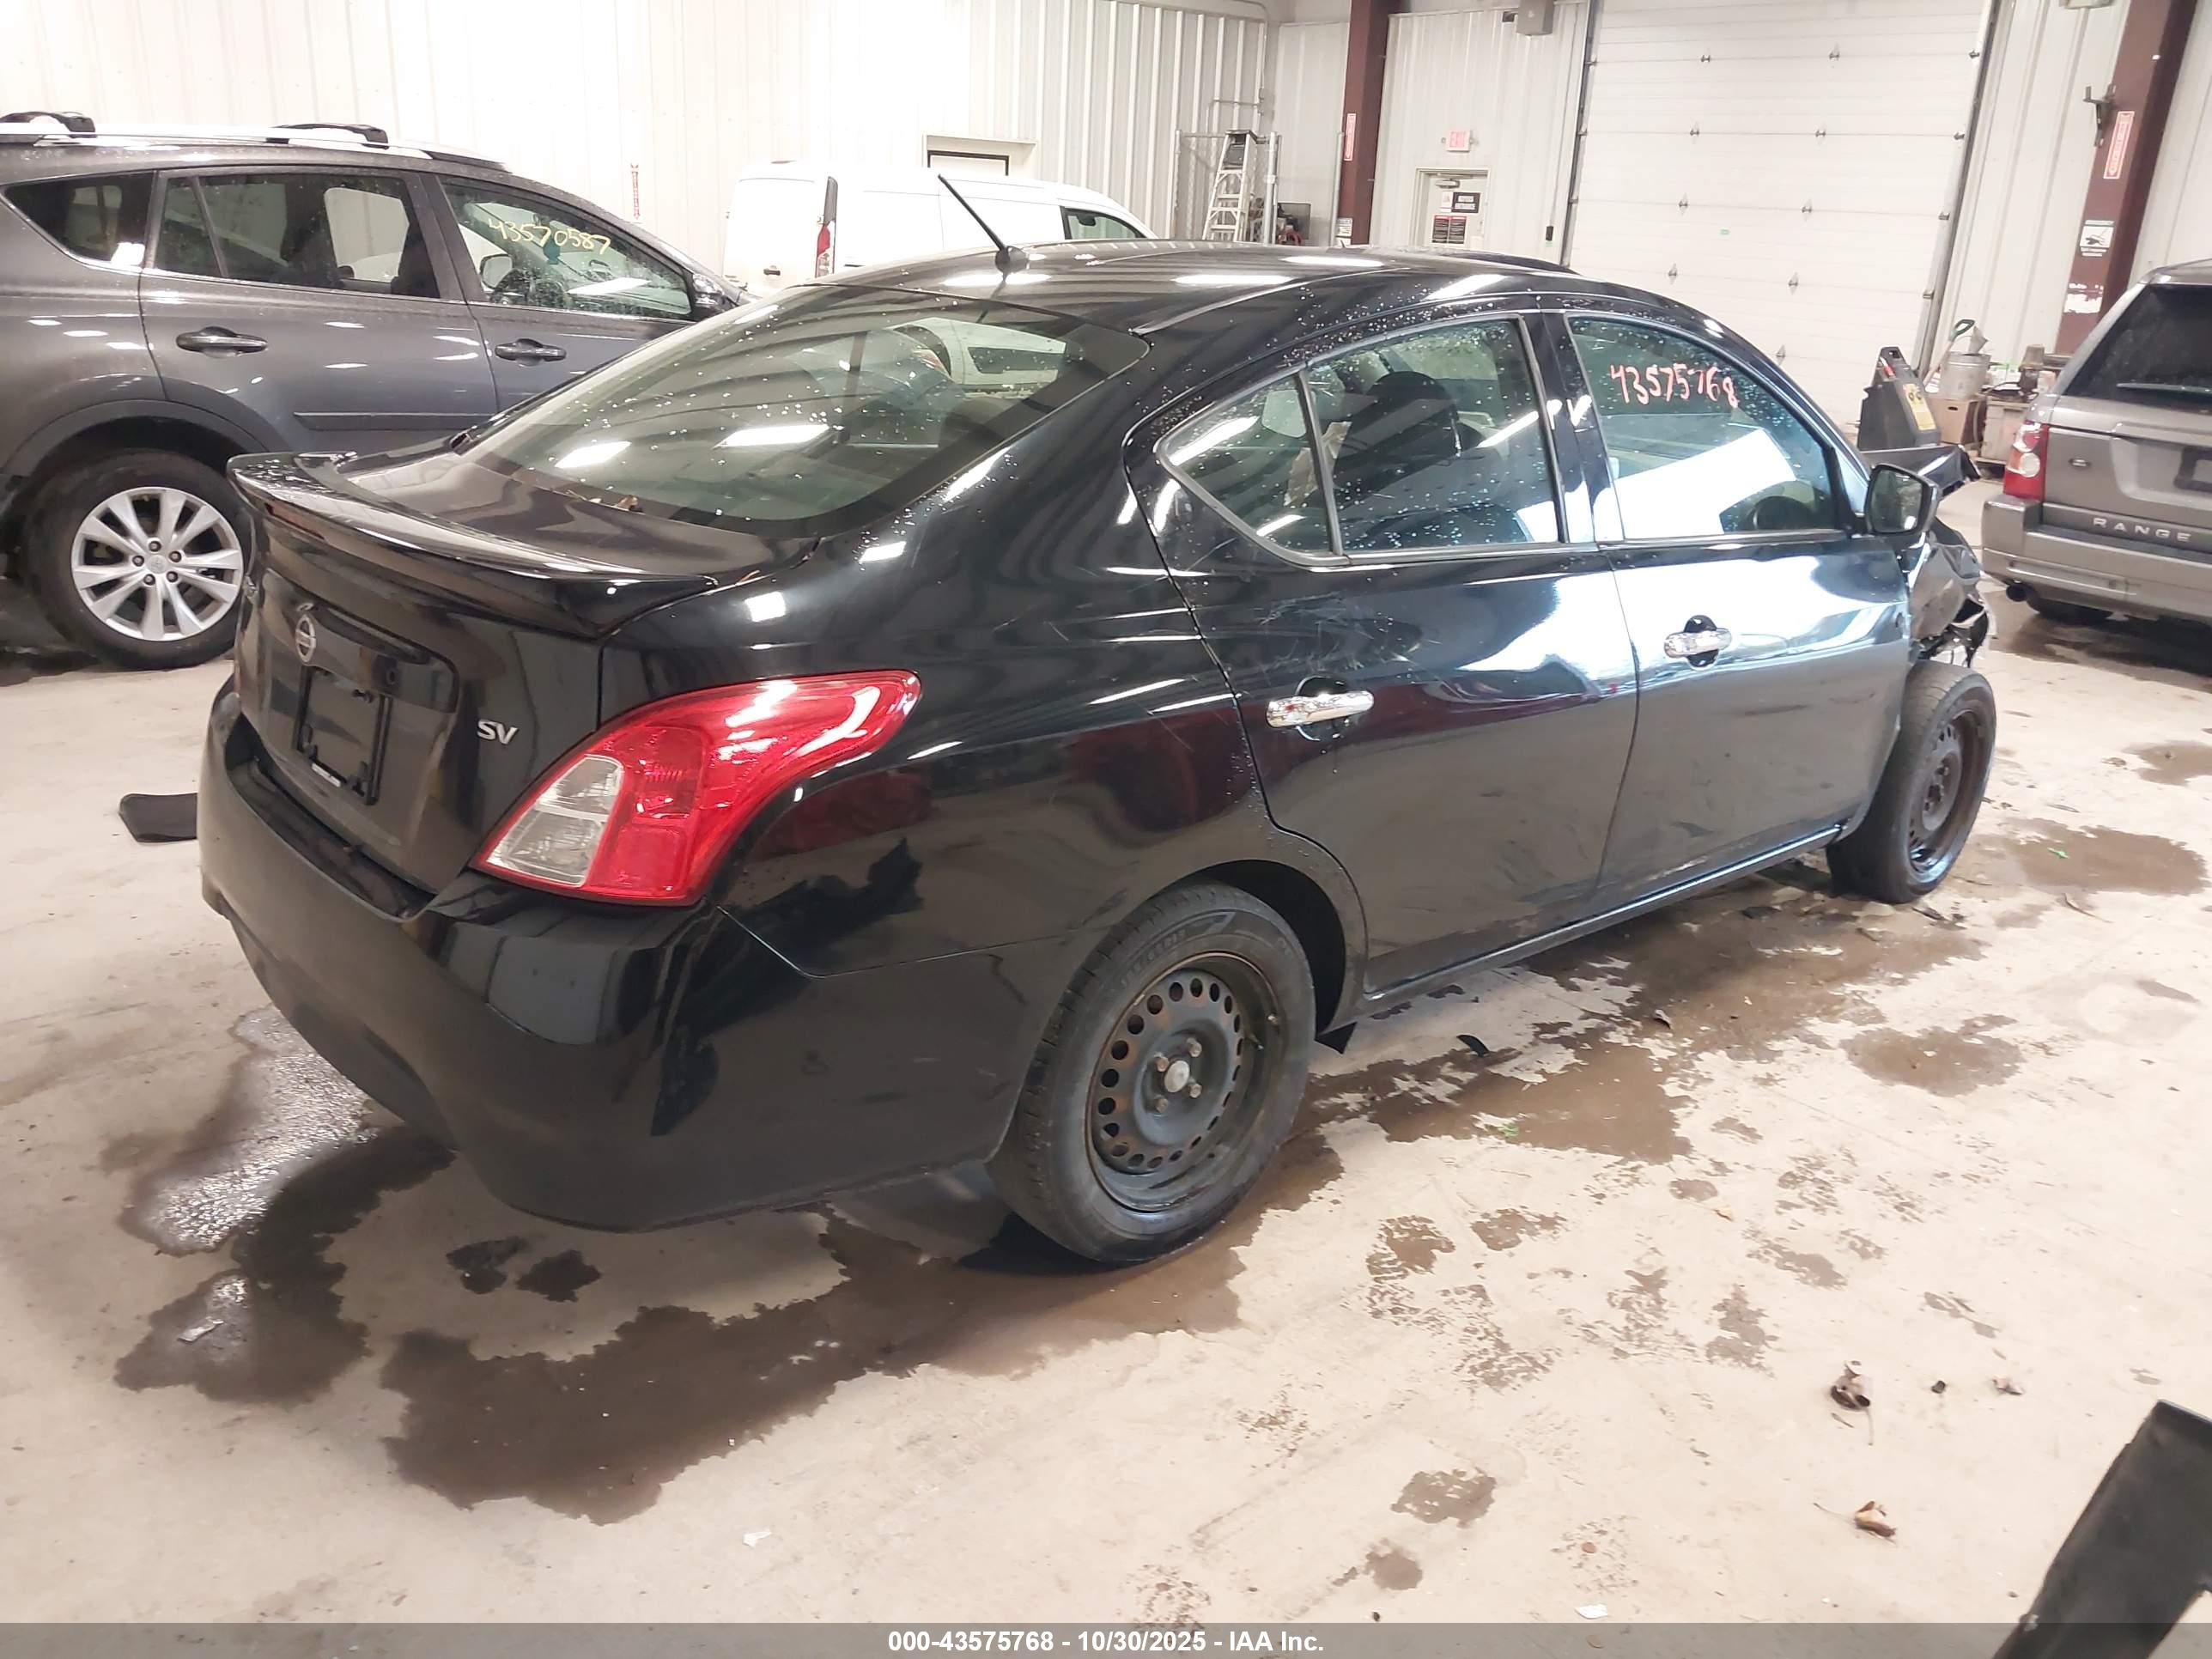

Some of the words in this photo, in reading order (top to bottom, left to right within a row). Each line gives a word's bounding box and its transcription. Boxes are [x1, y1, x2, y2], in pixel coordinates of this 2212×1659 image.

[489, 218, 611, 255] 43570587
[1609, 363, 1740, 409] 43575768
[2093, 517, 2191, 542] RANGE
[477, 719, 518, 744] SV
